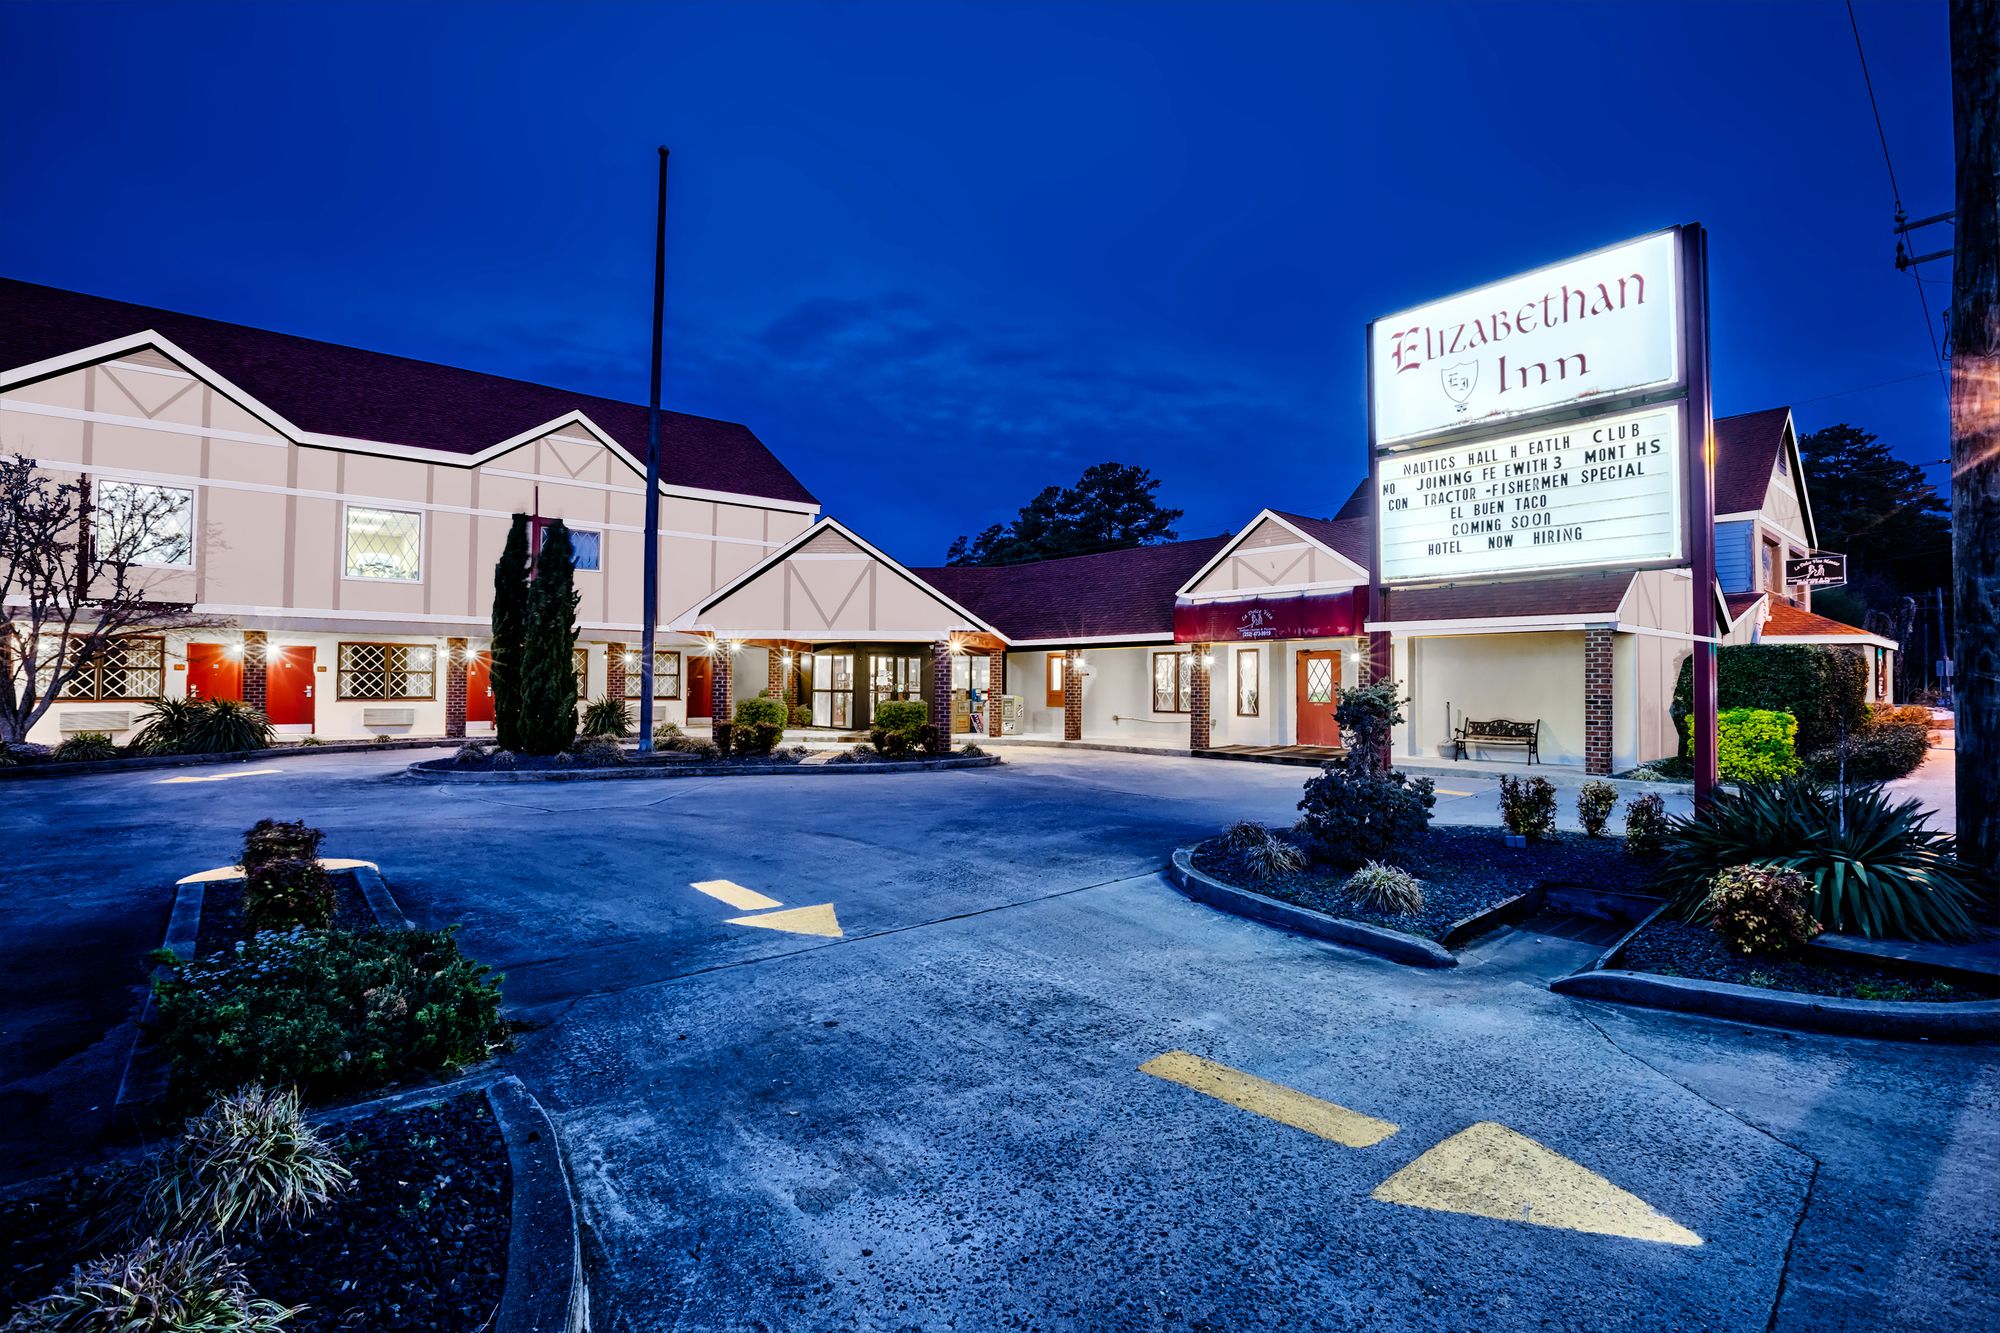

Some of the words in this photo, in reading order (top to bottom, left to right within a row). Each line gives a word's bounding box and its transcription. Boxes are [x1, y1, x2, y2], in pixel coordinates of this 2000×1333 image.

[1498, 352, 1591, 395] Inn
[1403, 455, 1455, 475] NAUTICS
[1468, 446, 1499, 465] HALL
[1592, 423, 1640, 444] CLUB
[1382, 482, 1396, 496] NO
[1416, 467, 1473, 491] JOINING
[1553, 456, 1562, 470] 3
[1388, 497, 1409, 512] CON
[1423, 486, 1476, 507] TRACTOR
[1580, 461, 1646, 484] SPECIAL
[1450, 505, 1464, 520] EL
[1473, 499, 1505, 517] BUEN
[1515, 494, 1548, 512] TACO
[1451, 517, 1503, 537] COMING
[1511, 511, 1552, 530] SOON
[1427, 539, 1464, 557] HOTEL
[1487, 534, 1515, 550] NOW
[1533, 526, 1584, 547] HIRING
